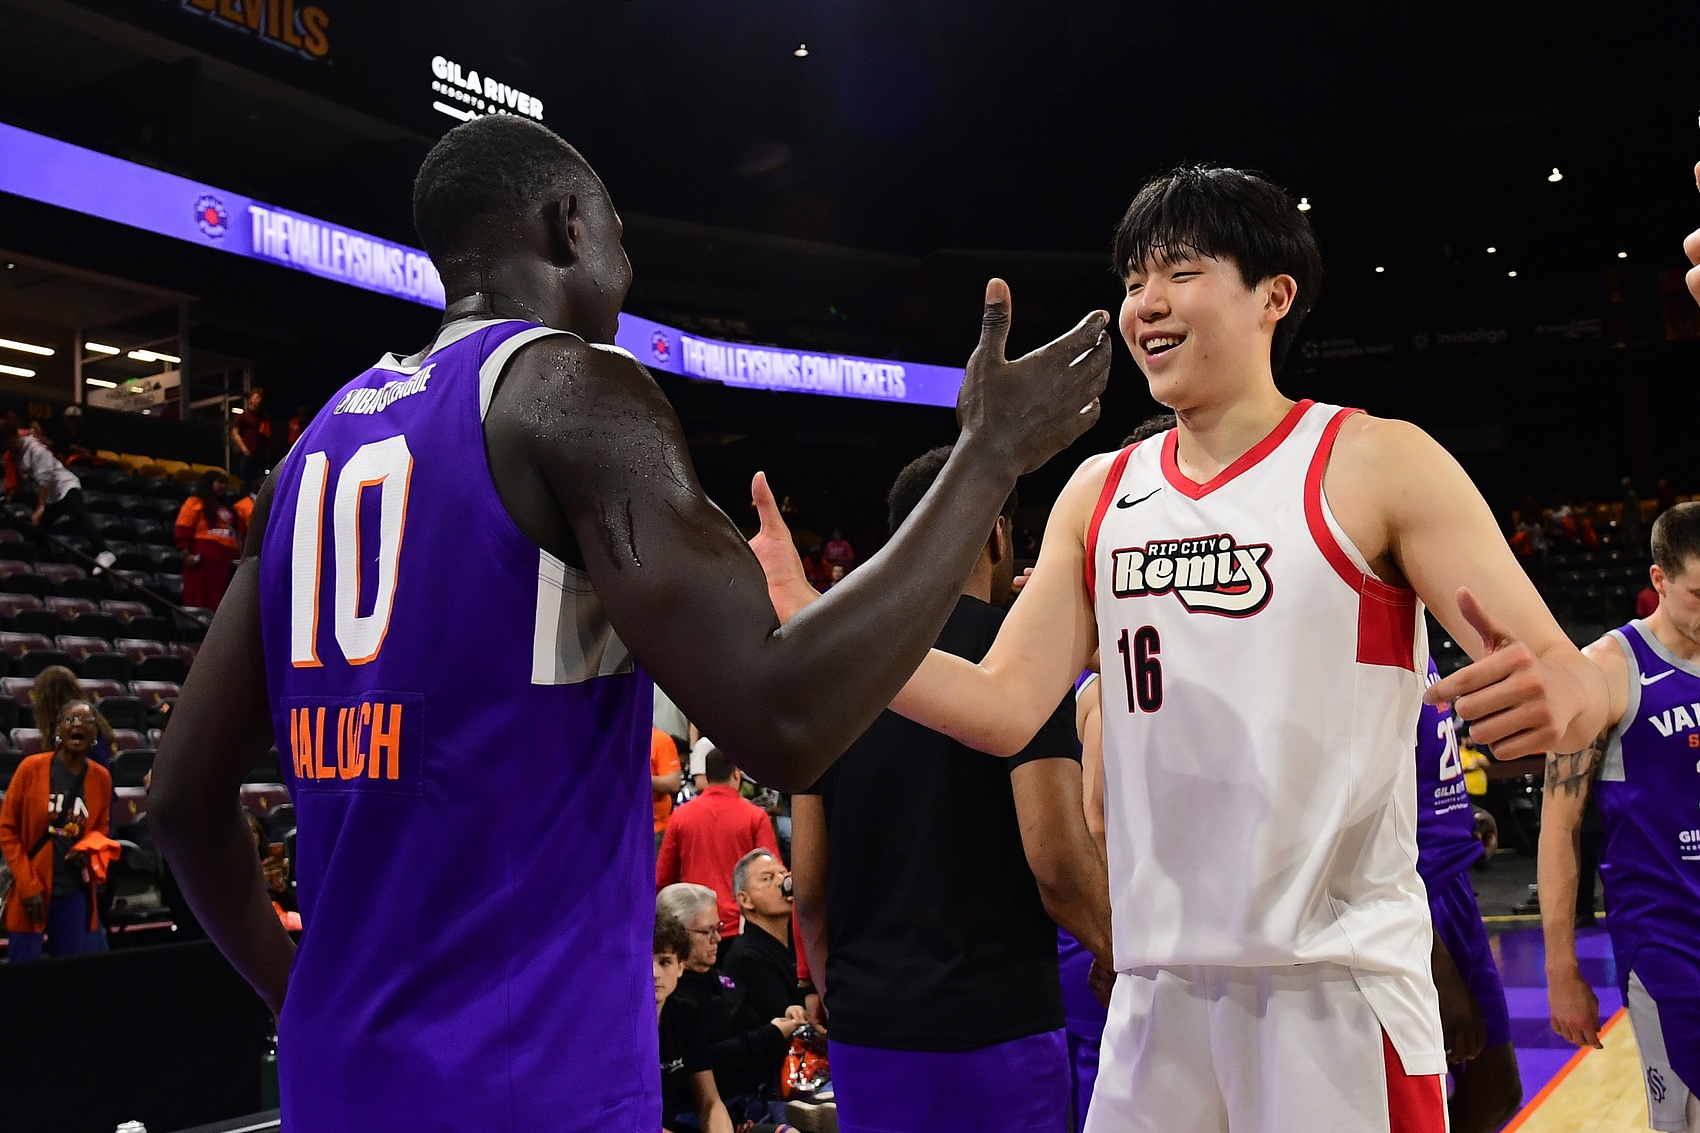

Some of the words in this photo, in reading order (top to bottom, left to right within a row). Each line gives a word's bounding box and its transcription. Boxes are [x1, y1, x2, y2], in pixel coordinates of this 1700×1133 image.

[431, 56, 482, 95] GILA
[483, 77, 544, 120] RIVER
[679, 335, 907, 399] THEVALLEYSUNS.COM/TICKETS
[291, 434, 414, 667] 10
[1113, 536, 1269, 614] Remix
[1147, 542, 1178, 557] RIP
[1180, 538, 1217, 555] CITY
[1117, 625, 1164, 713] 16
